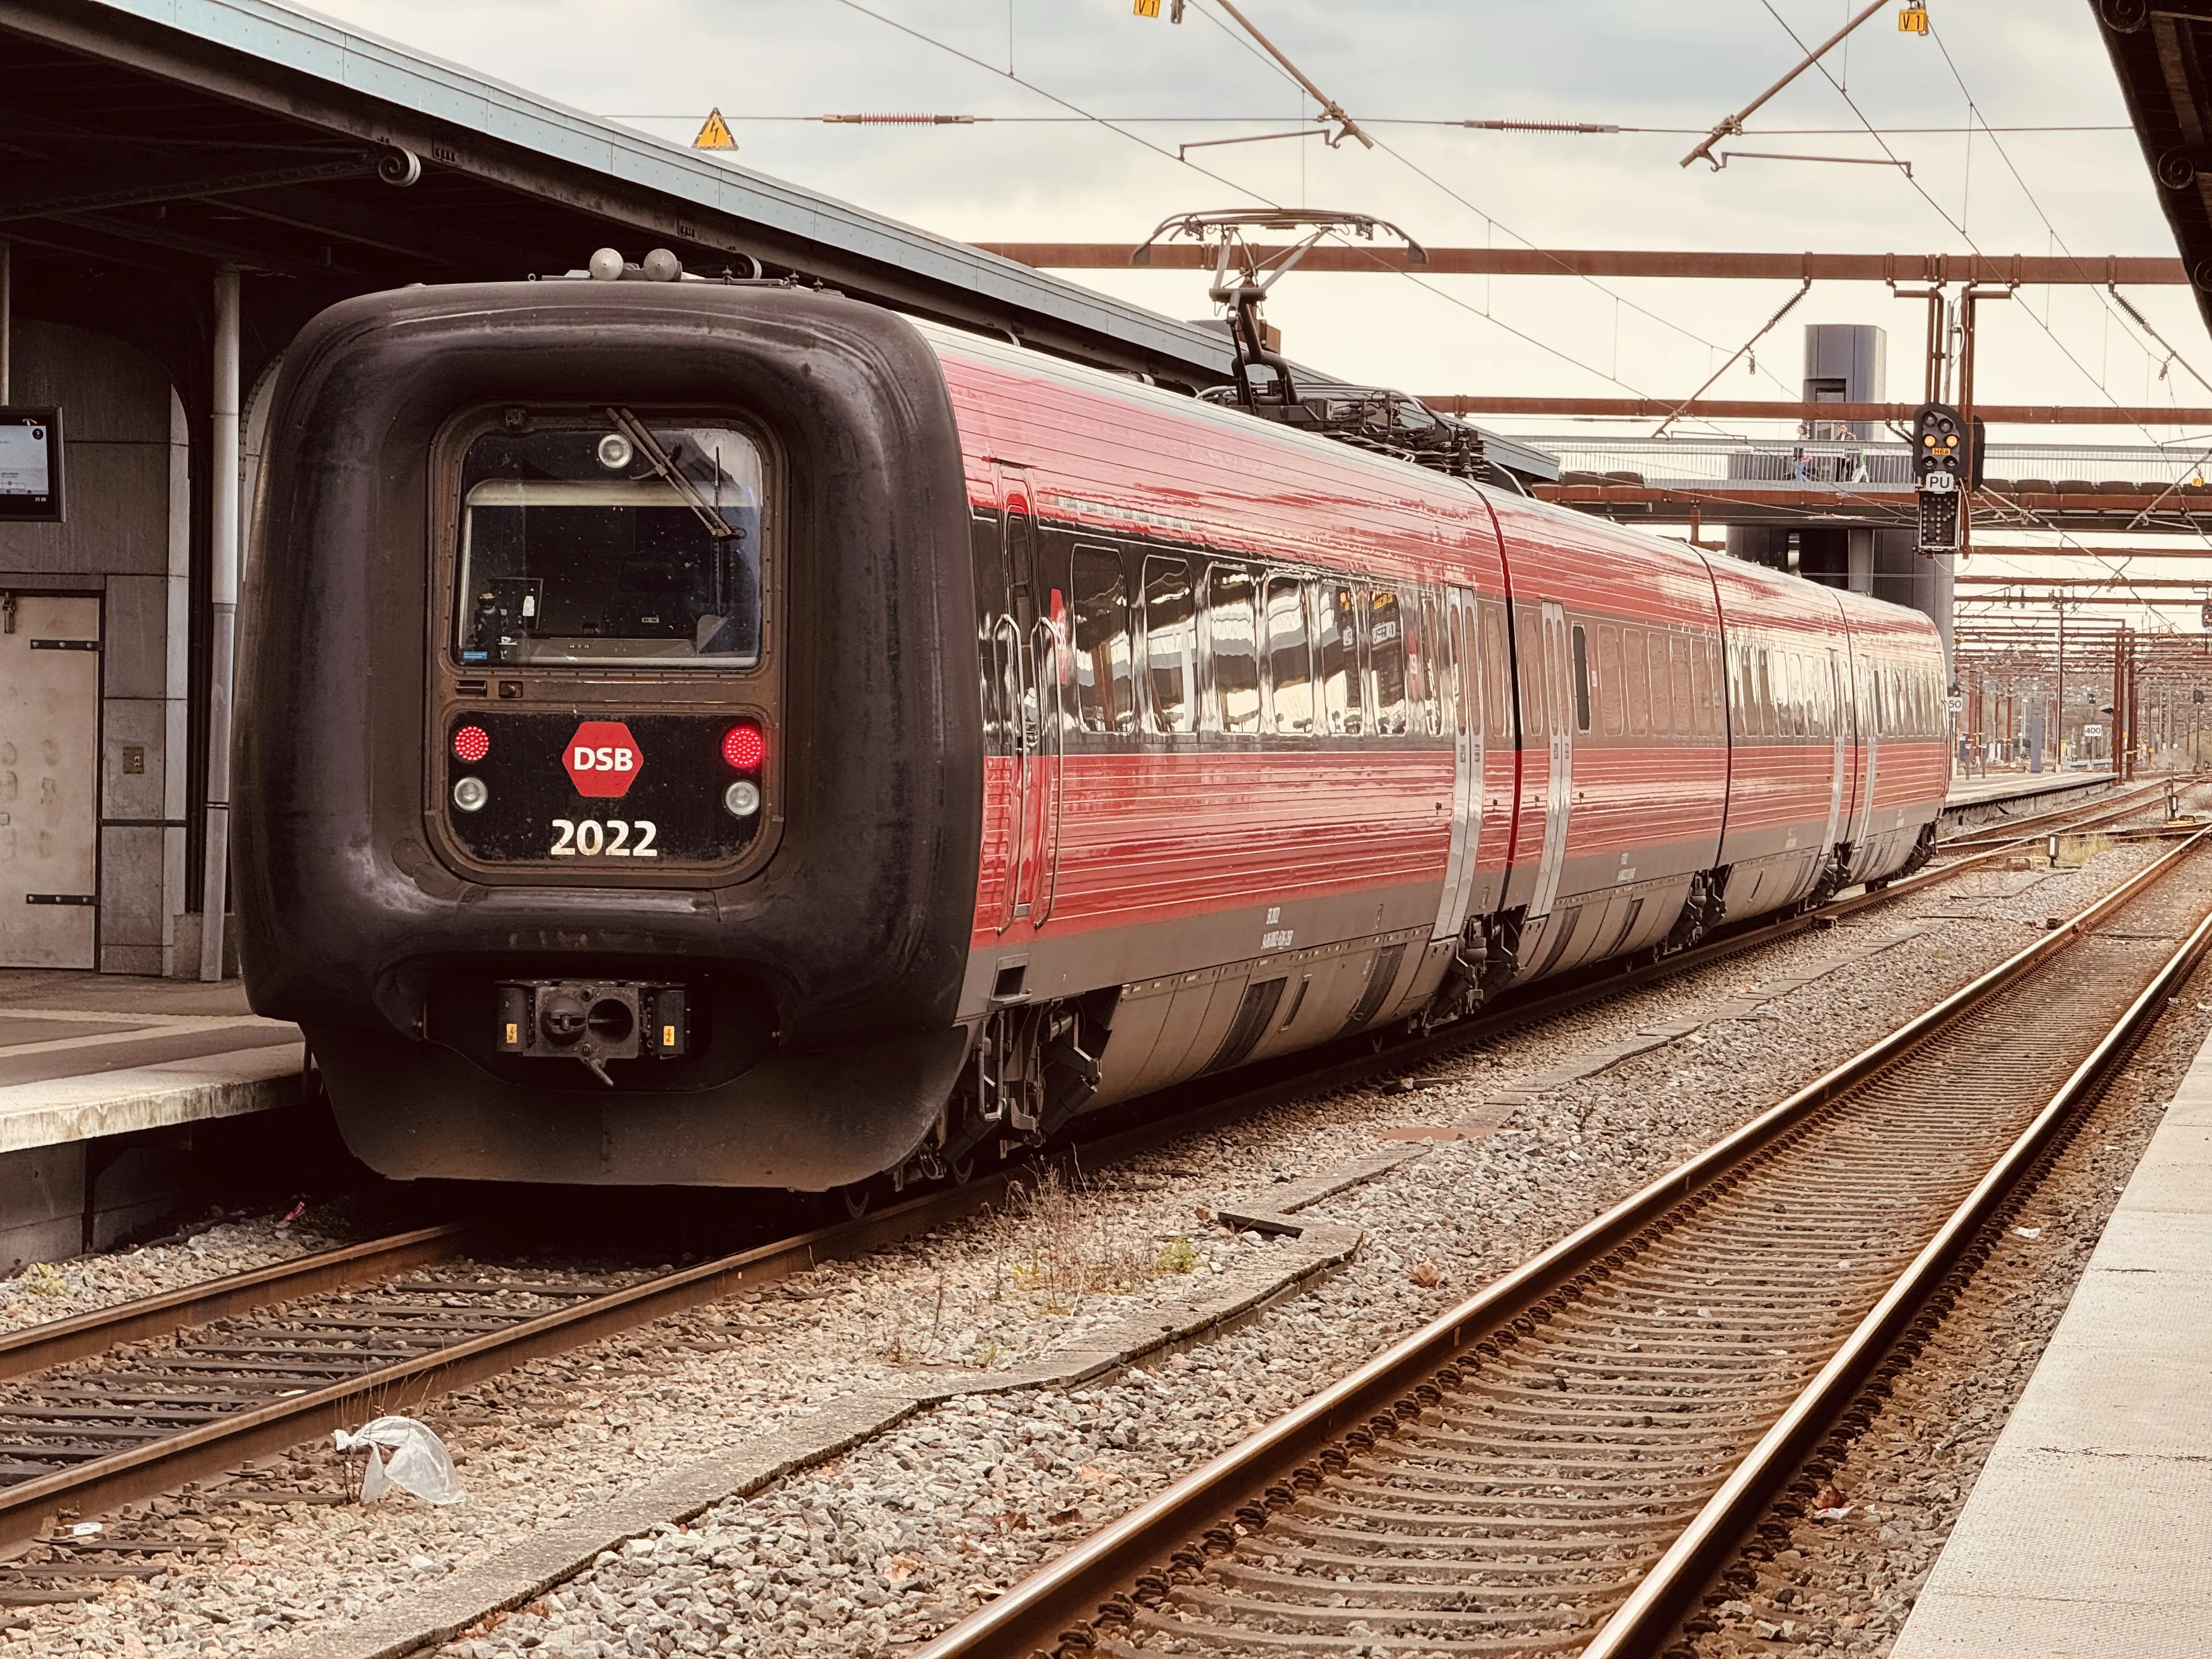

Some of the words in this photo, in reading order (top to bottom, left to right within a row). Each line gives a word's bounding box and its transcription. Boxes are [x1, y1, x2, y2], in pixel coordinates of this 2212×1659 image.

[1929, 477, 1950, 489] PU
[574, 747, 633, 771] DSB
[550, 819, 658, 857] 2022
